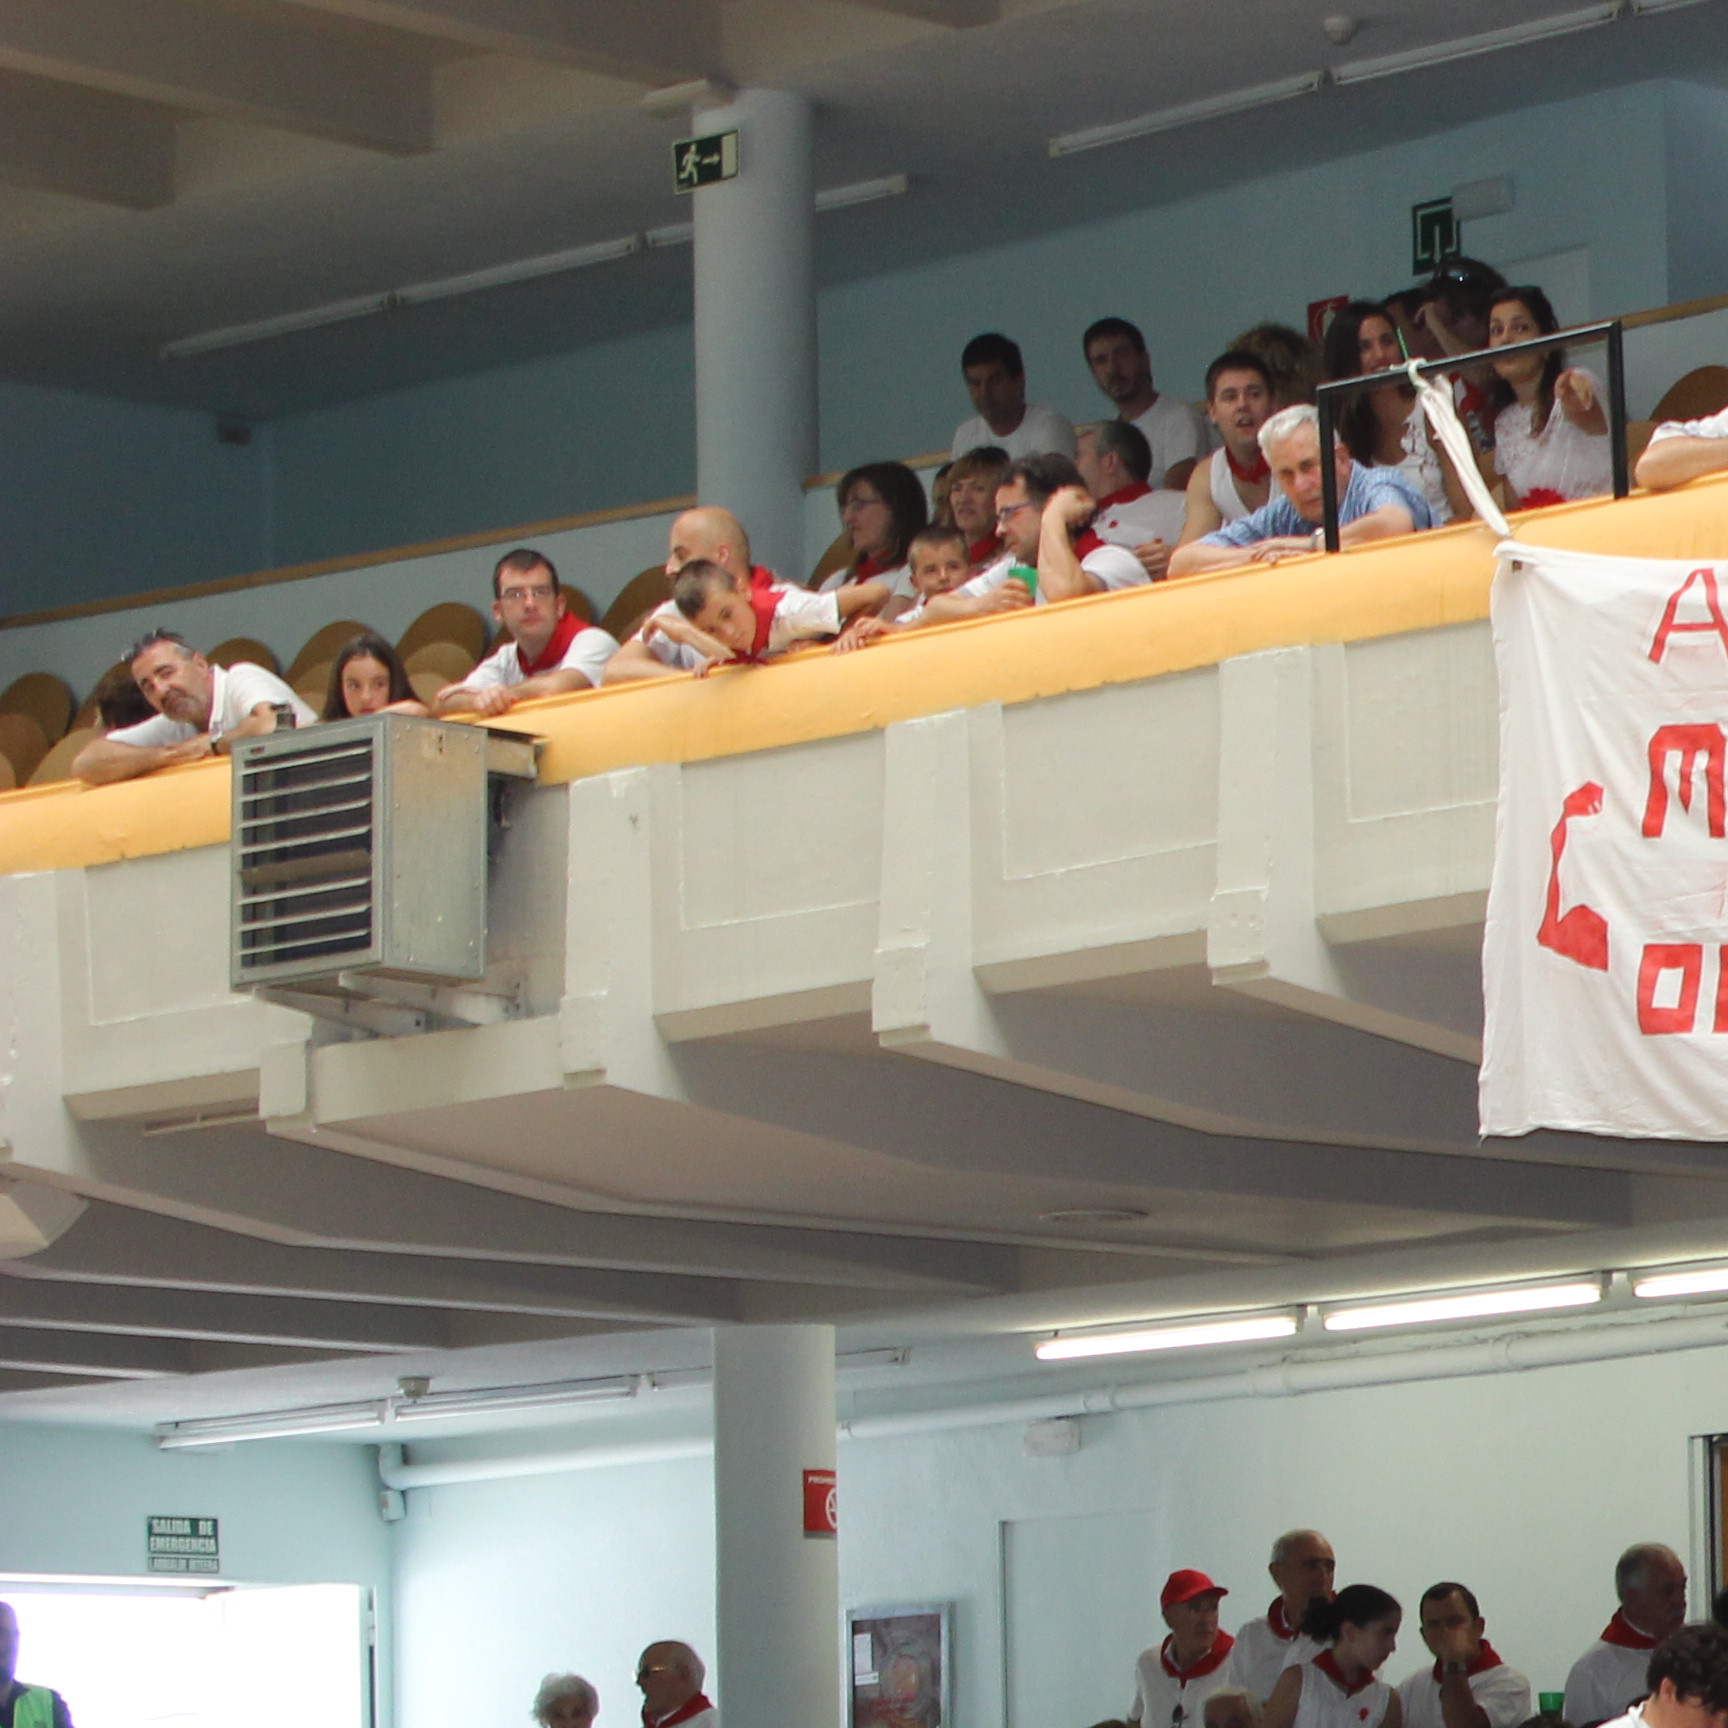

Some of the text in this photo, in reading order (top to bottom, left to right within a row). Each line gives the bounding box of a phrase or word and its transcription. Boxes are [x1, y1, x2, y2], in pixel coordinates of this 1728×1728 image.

[151, 1518, 215, 1536] SALIDA DE
[149, 1536, 217, 1553] EMERGENCIA
